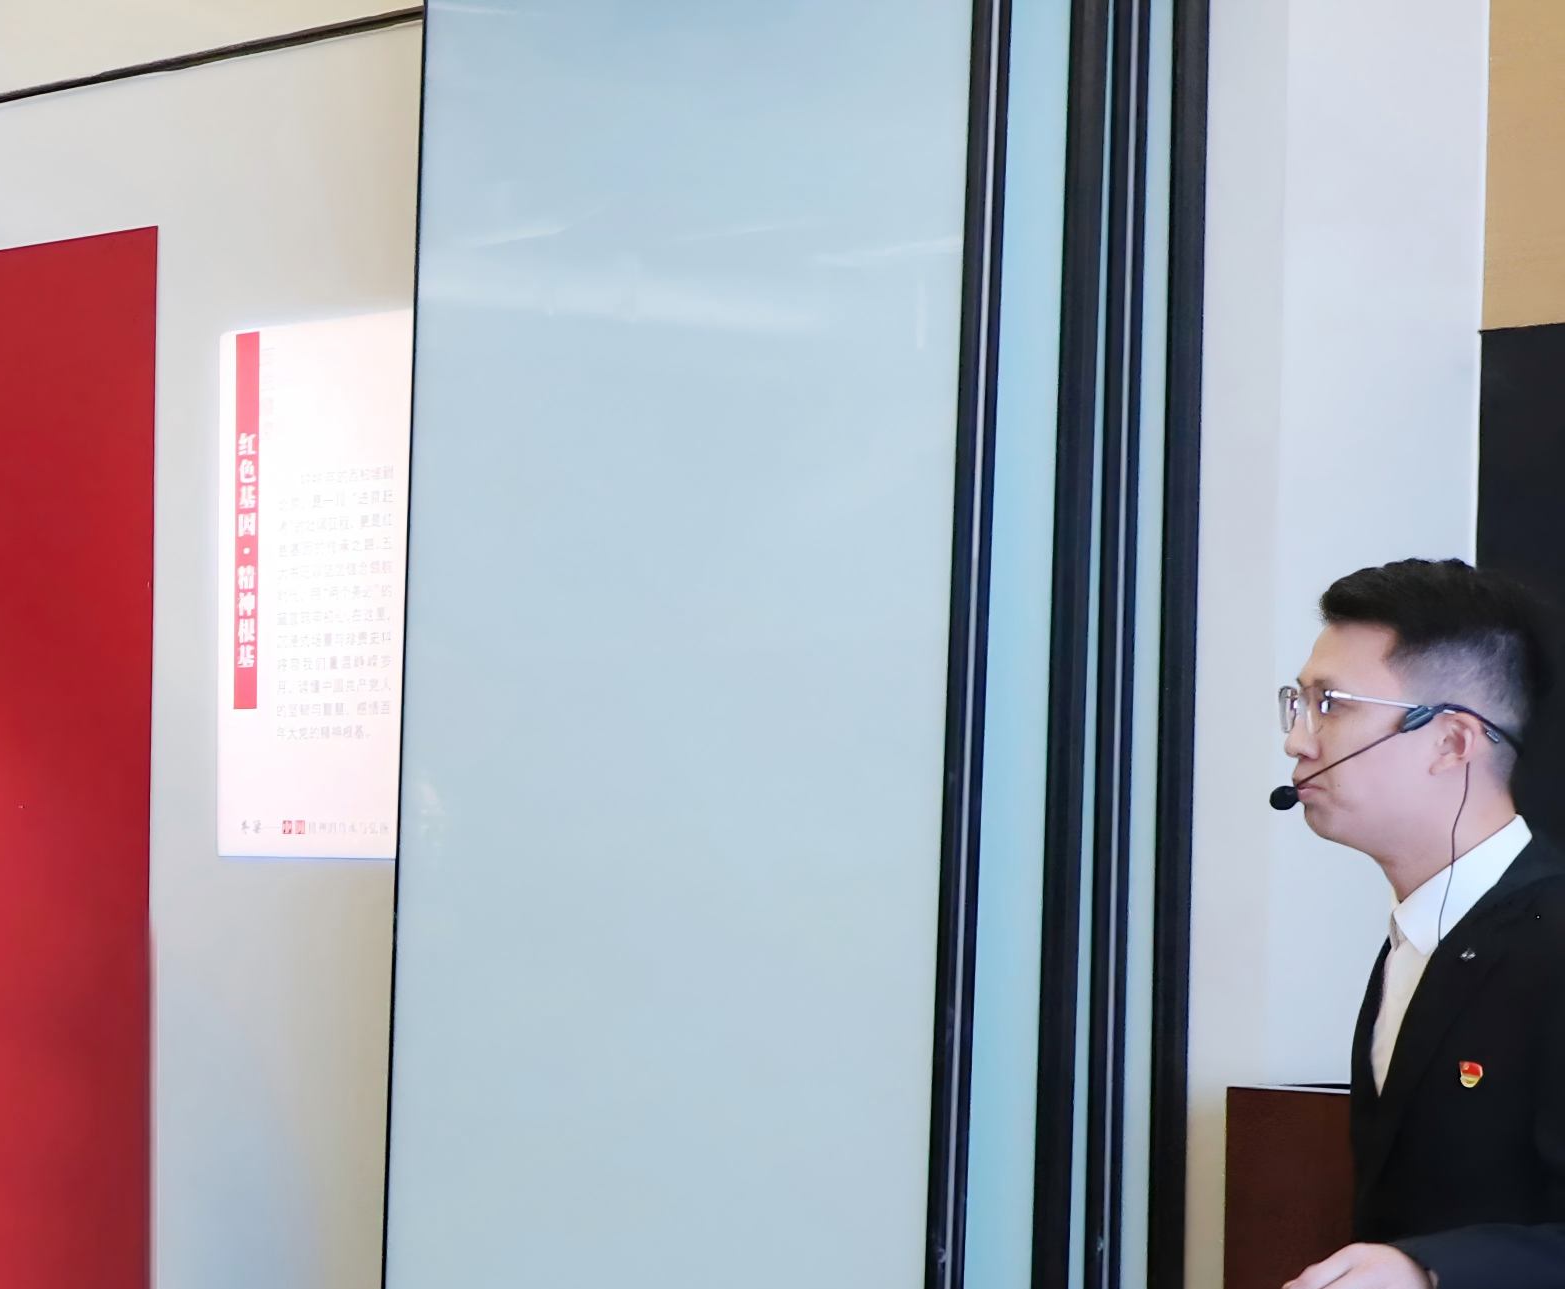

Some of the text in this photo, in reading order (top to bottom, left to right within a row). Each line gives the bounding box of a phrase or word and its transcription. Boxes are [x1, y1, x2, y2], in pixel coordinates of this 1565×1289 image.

[237, 432, 257, 668] 红色基因·精神根基
